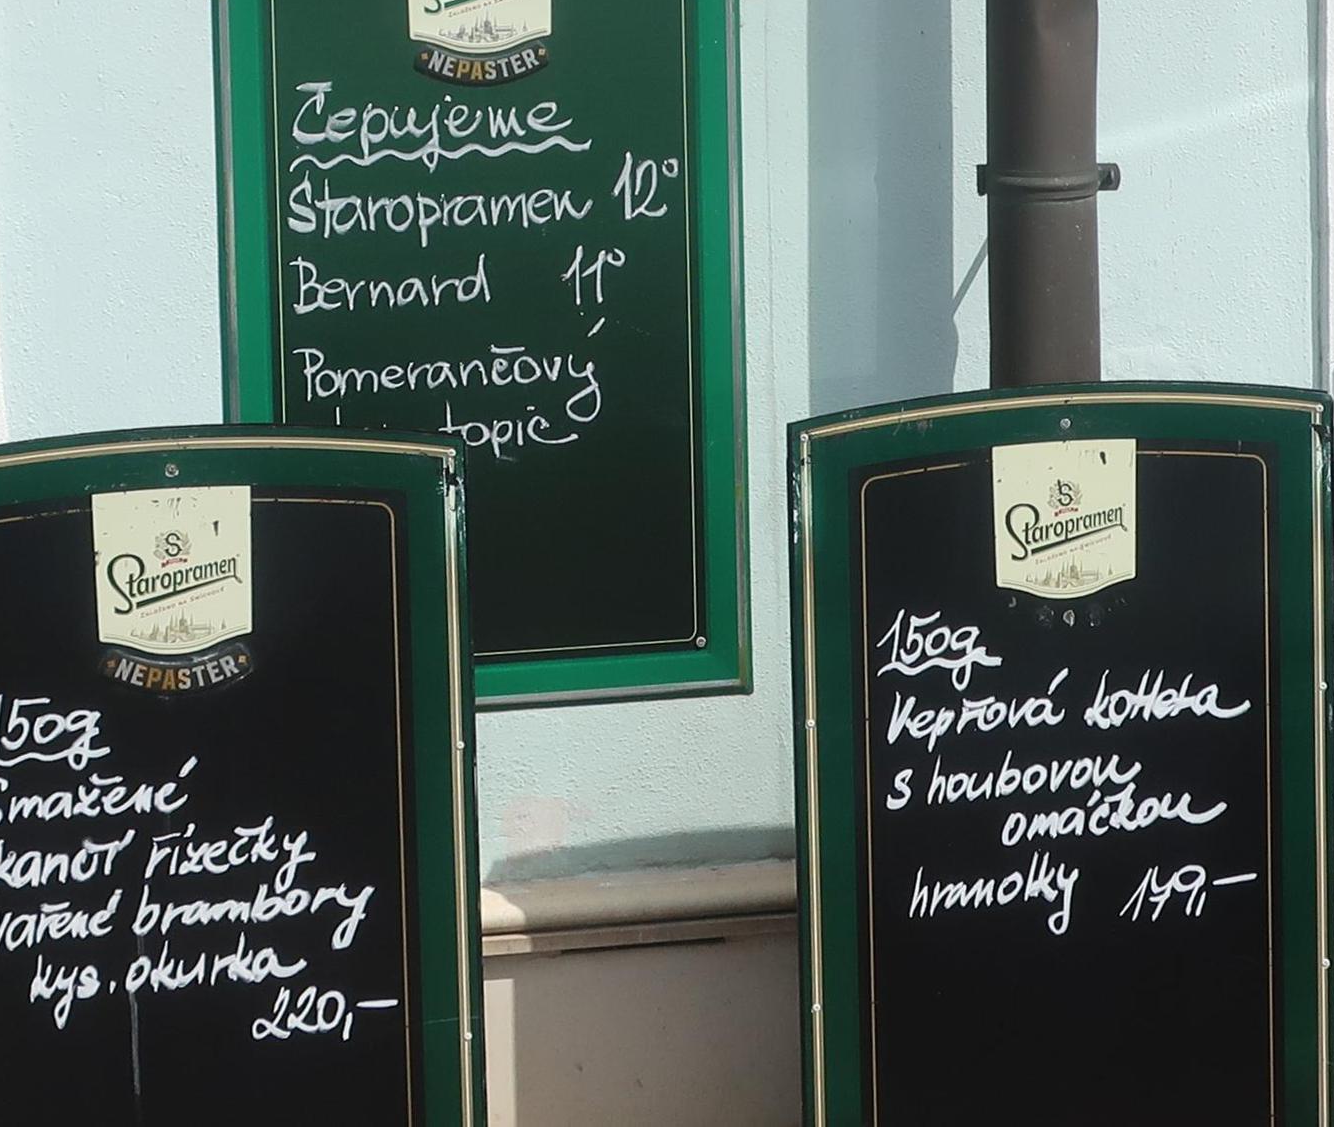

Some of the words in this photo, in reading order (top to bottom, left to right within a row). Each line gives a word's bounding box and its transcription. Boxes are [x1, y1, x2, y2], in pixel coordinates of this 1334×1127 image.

[427, 48, 540, 80] NEPASTER
[293, 81, 573, 172] Čepujeme
[287, 171, 593, 247] Staropramen
[289, 253, 491, 314] Bernard
[292, 317, 606, 423] Pomerančový
[1005, 503, 1128, 561] Staropramen
[107, 553, 243, 615] Staropramen
[114, 654, 240, 690] NEPASTER
[877, 608, 987, 691] 150g
[886, 667, 1069, 752] Vepřová
[885, 767, 913, 811] s
[927, 750, 1142, 805] houbovou
[1001, 782, 1227, 847] omáčkou
[144, 816, 317, 892] řízečky
[132, 884, 375, 949] brambory
[909, 850, 1079, 935] hranolky
[125, 932, 307, 995] okurka
